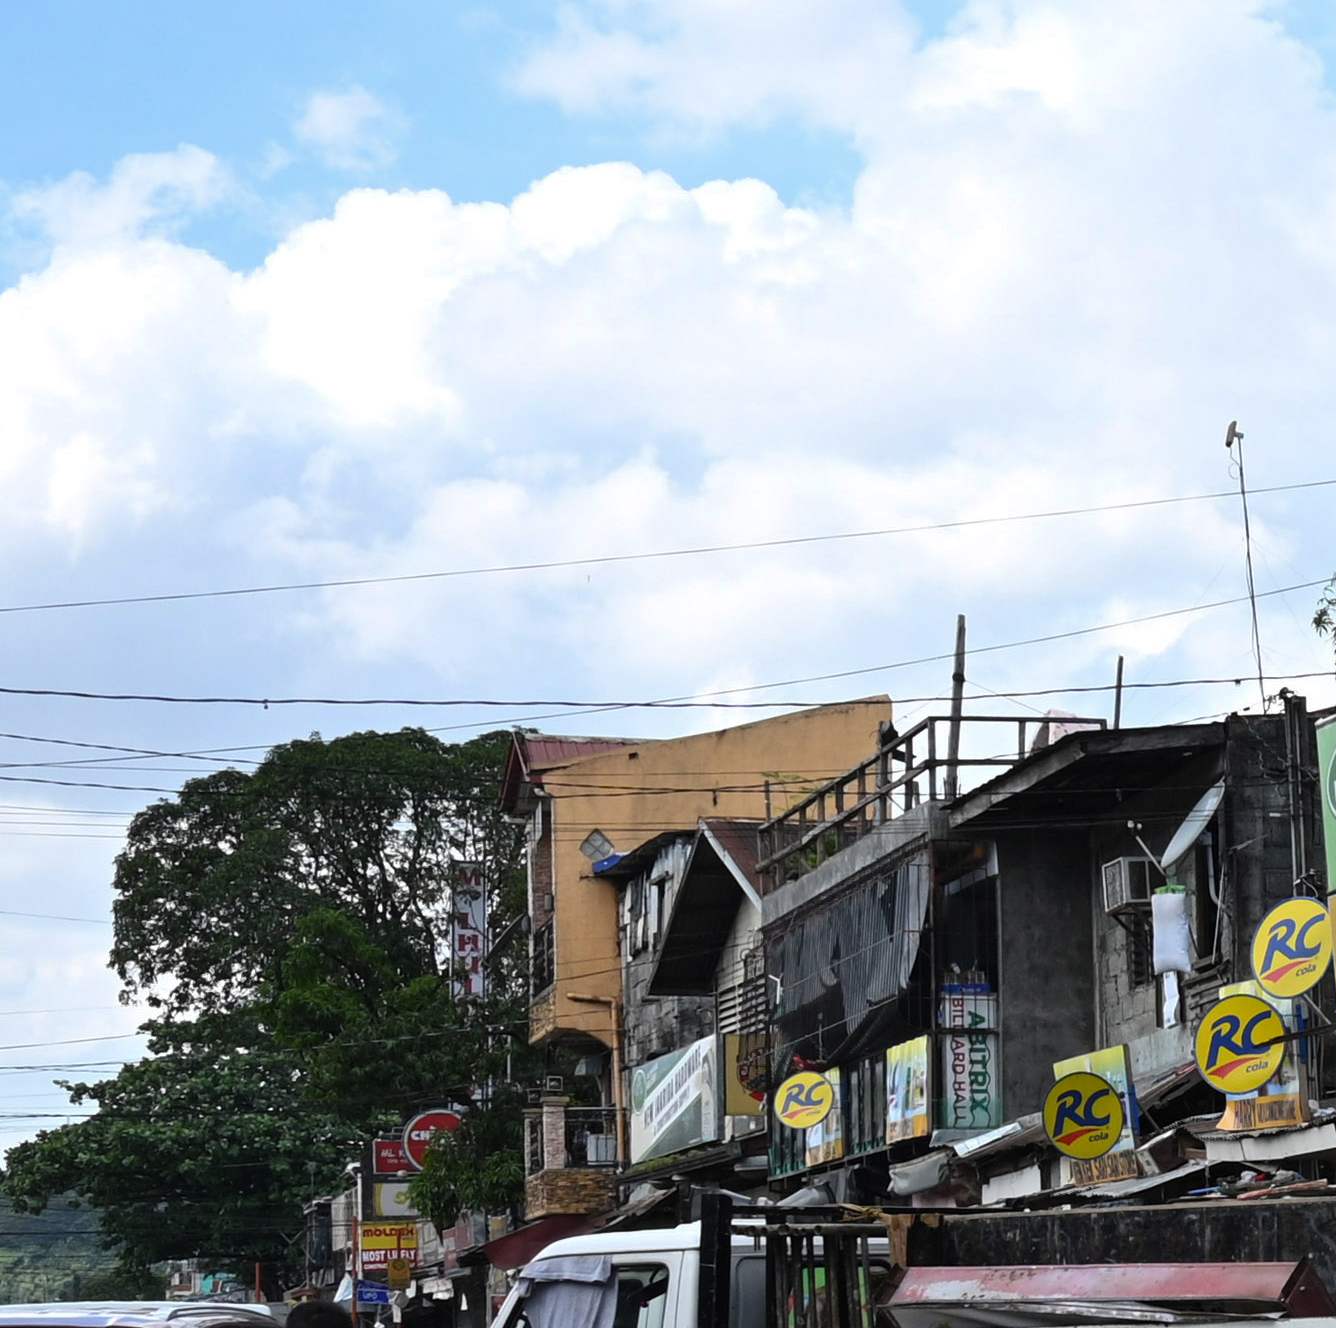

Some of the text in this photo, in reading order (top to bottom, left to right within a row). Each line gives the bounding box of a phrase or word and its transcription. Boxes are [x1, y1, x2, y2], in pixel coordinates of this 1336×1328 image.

[1261, 912, 1326, 976] RC
[1295, 963, 1316, 978] cola
[1206, 1010, 1274, 1071] RC
[1245, 1060, 1269, 1074] cola
[782, 1080, 826, 1115] RC
[1053, 1087, 1112, 1138] RC
[1088, 1130, 1110, 1143] cola
